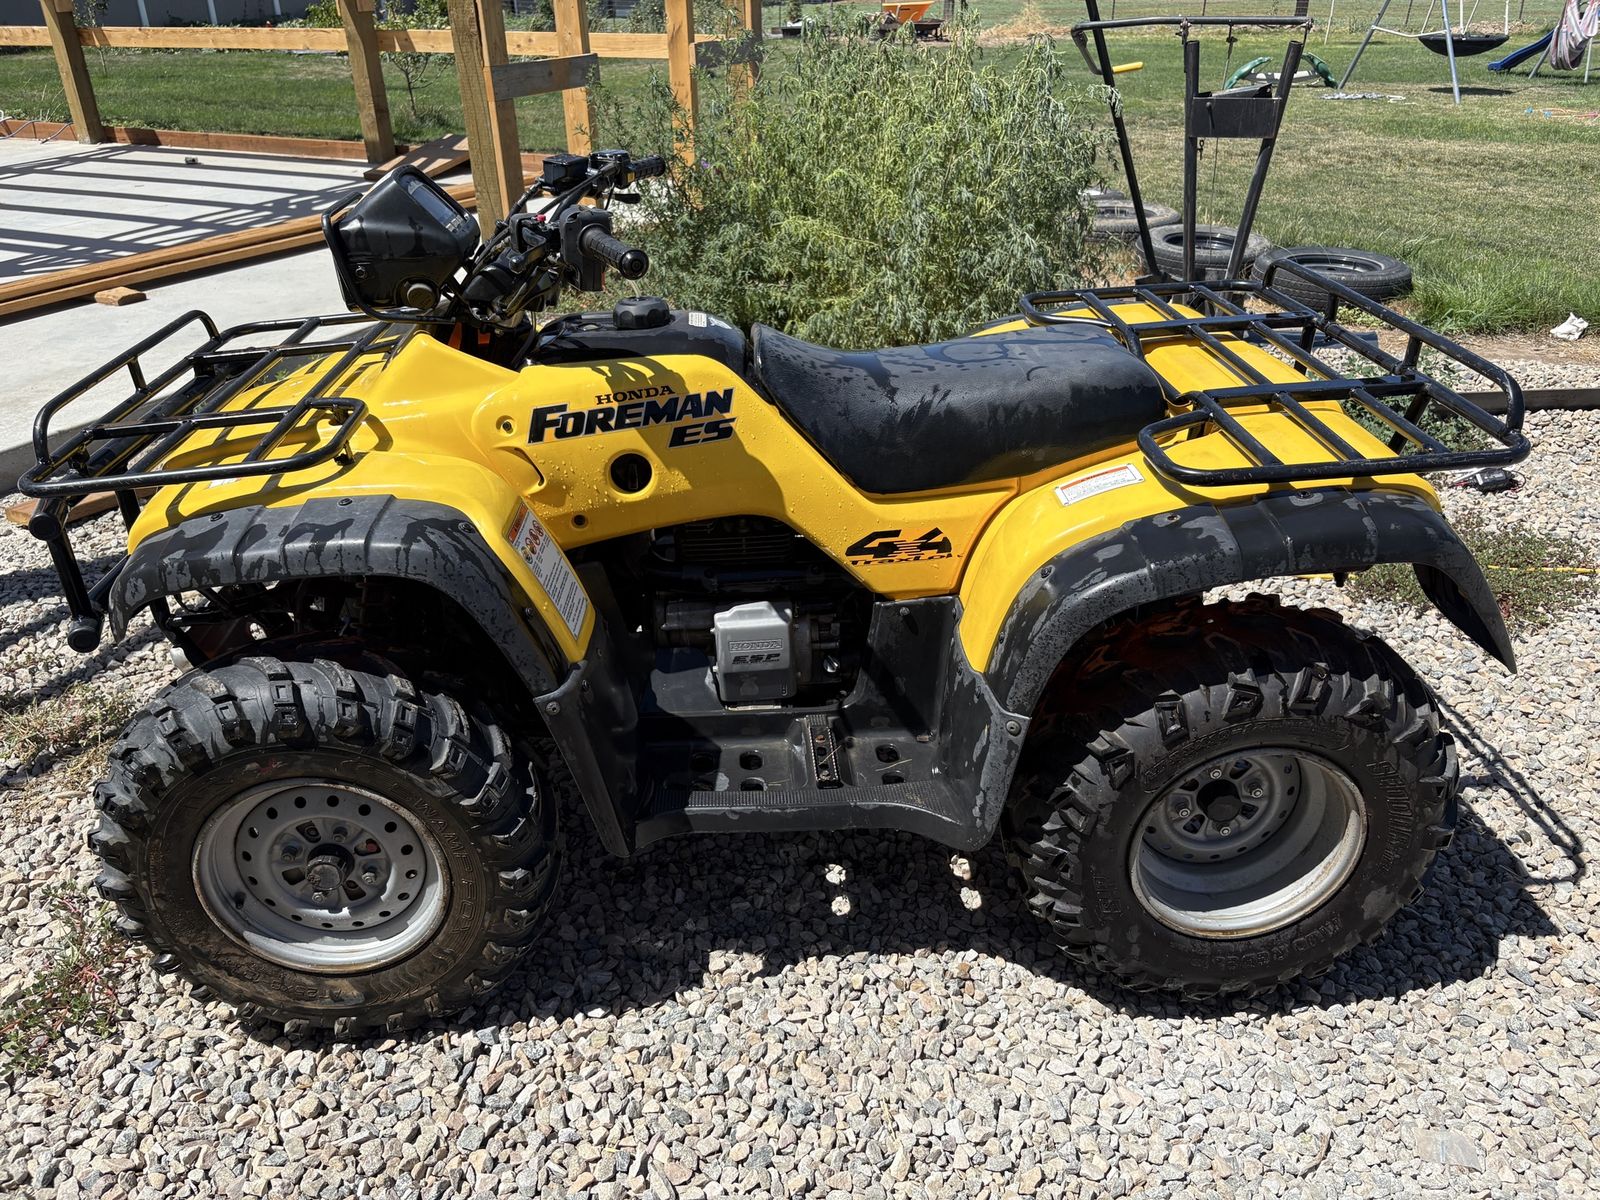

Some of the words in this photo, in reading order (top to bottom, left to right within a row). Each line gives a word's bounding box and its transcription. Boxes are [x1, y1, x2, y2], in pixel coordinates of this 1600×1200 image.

[595, 385, 676, 405] HONDA
[527, 387, 735, 445] FOREMAN
[668, 417, 738, 448] ES
[730, 640, 782, 652] HONDA
[732, 653, 781, 664] ESP
